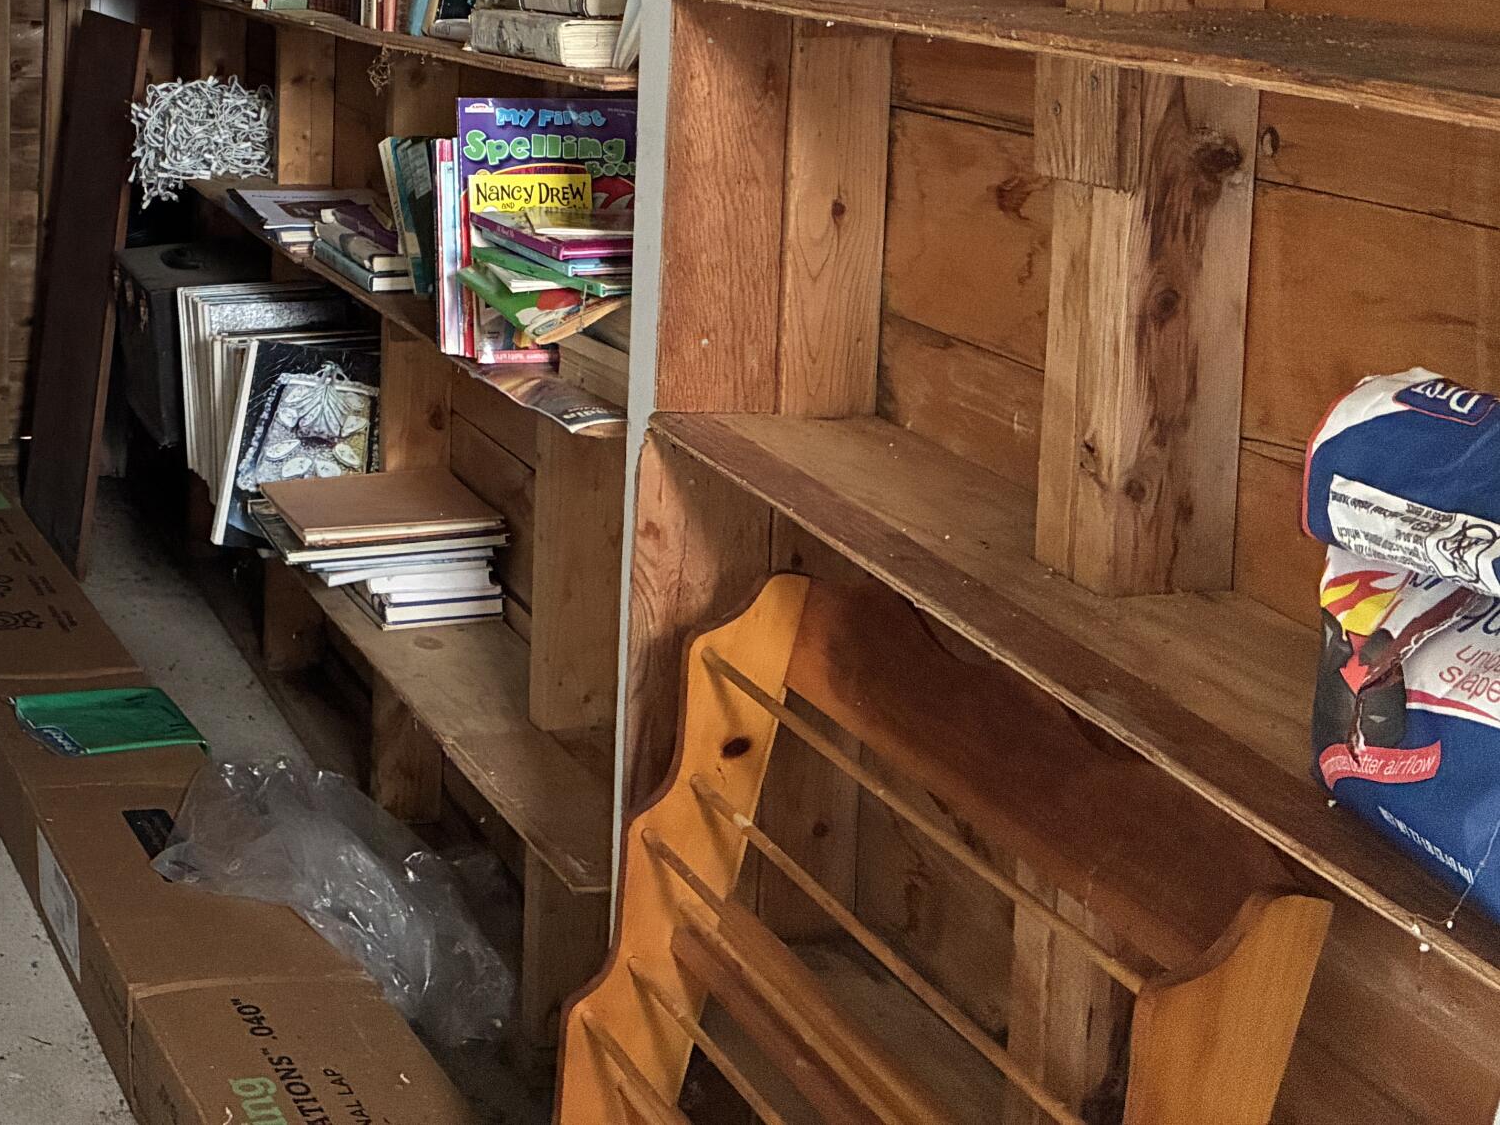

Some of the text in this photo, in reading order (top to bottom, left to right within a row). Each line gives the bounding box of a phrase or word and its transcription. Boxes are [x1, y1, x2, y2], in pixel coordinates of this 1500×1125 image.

[495, 107, 536, 128] My
[538, 108, 608, 128] First
[463, 129, 627, 166] Spelling
[537, 182, 587, 206] DREW
[1383, 754, 1437, 776] airflow
[322, 1068, 354, 1096] LAP
